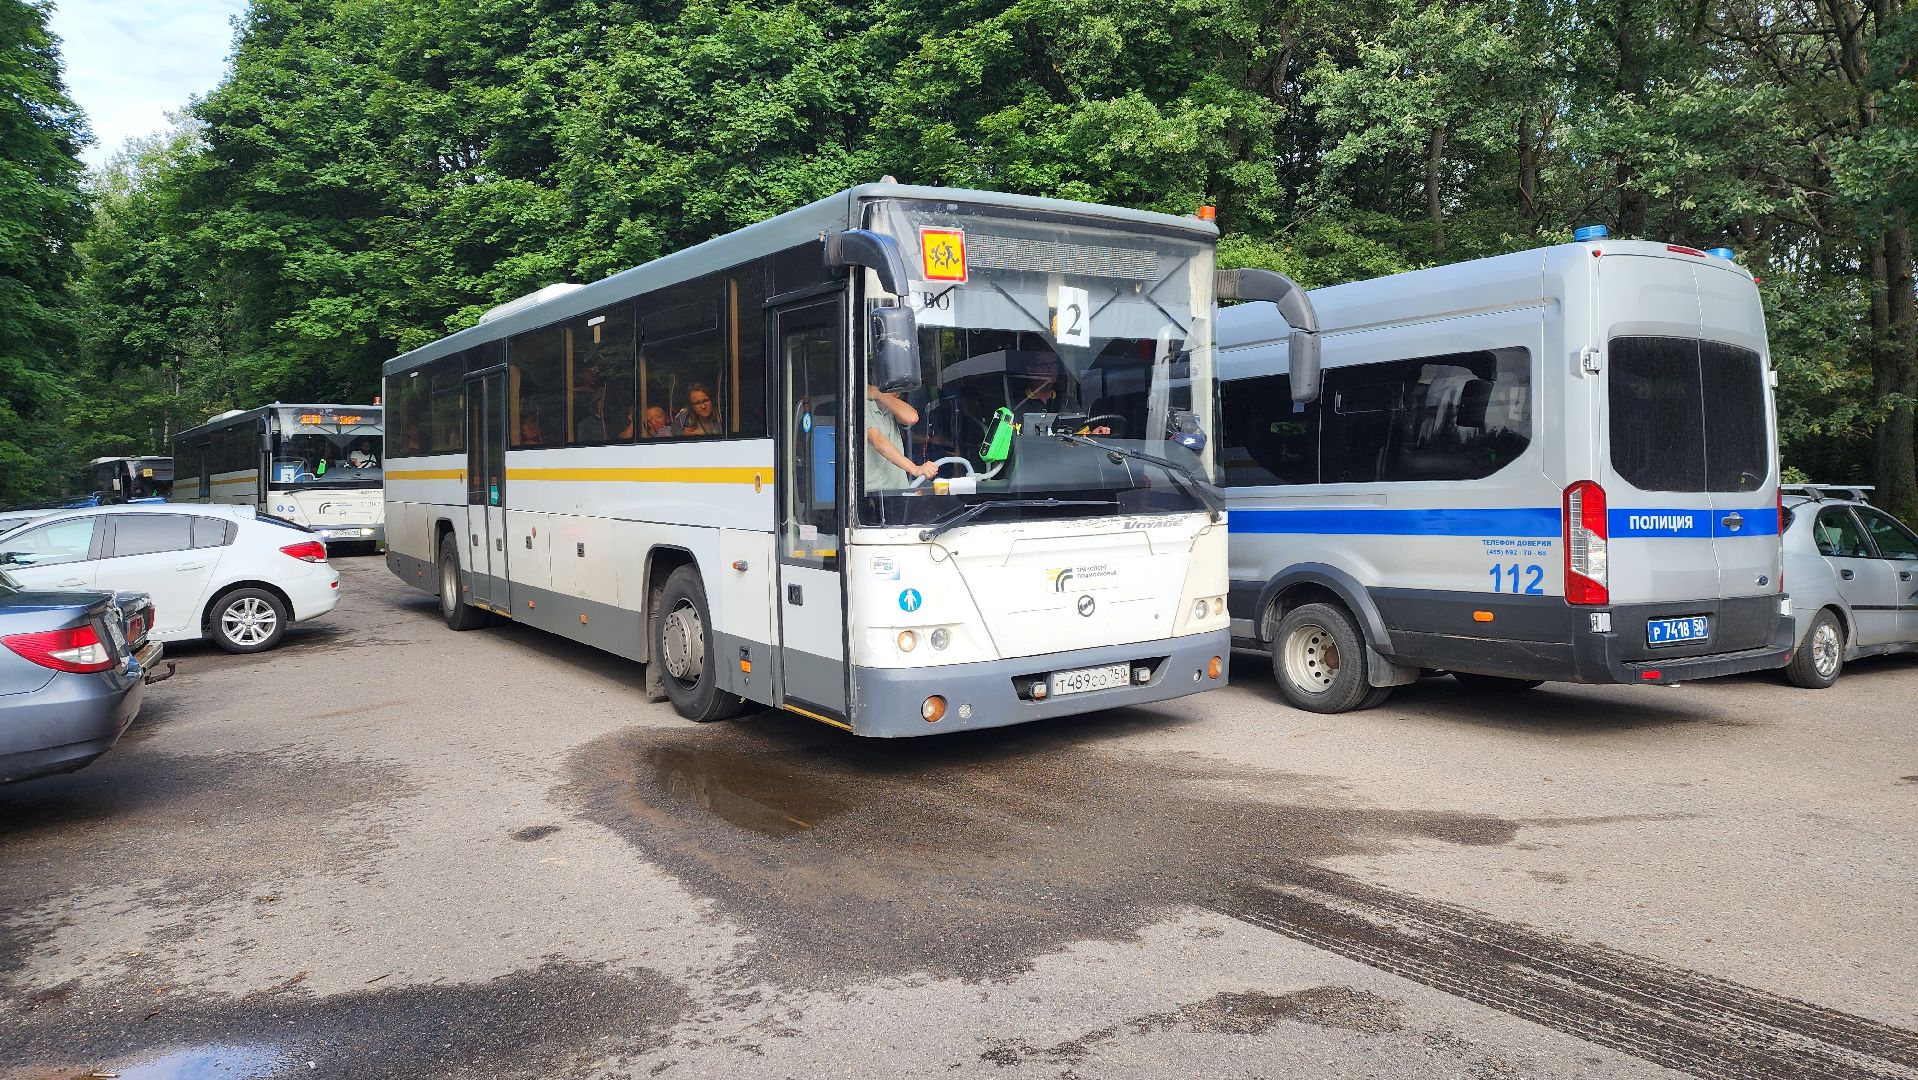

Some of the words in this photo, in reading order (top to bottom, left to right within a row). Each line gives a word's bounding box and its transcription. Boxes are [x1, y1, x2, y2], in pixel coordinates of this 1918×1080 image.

[1065, 303, 1082, 337] 2
[284, 473, 291, 483] 3
[1629, 515, 1693, 533] ПОЛИЦИЯ
[1489, 563, 1544, 595] 112
[1663, 621, 1690, 639] 7418
[1693, 618, 1704, 632] 50
